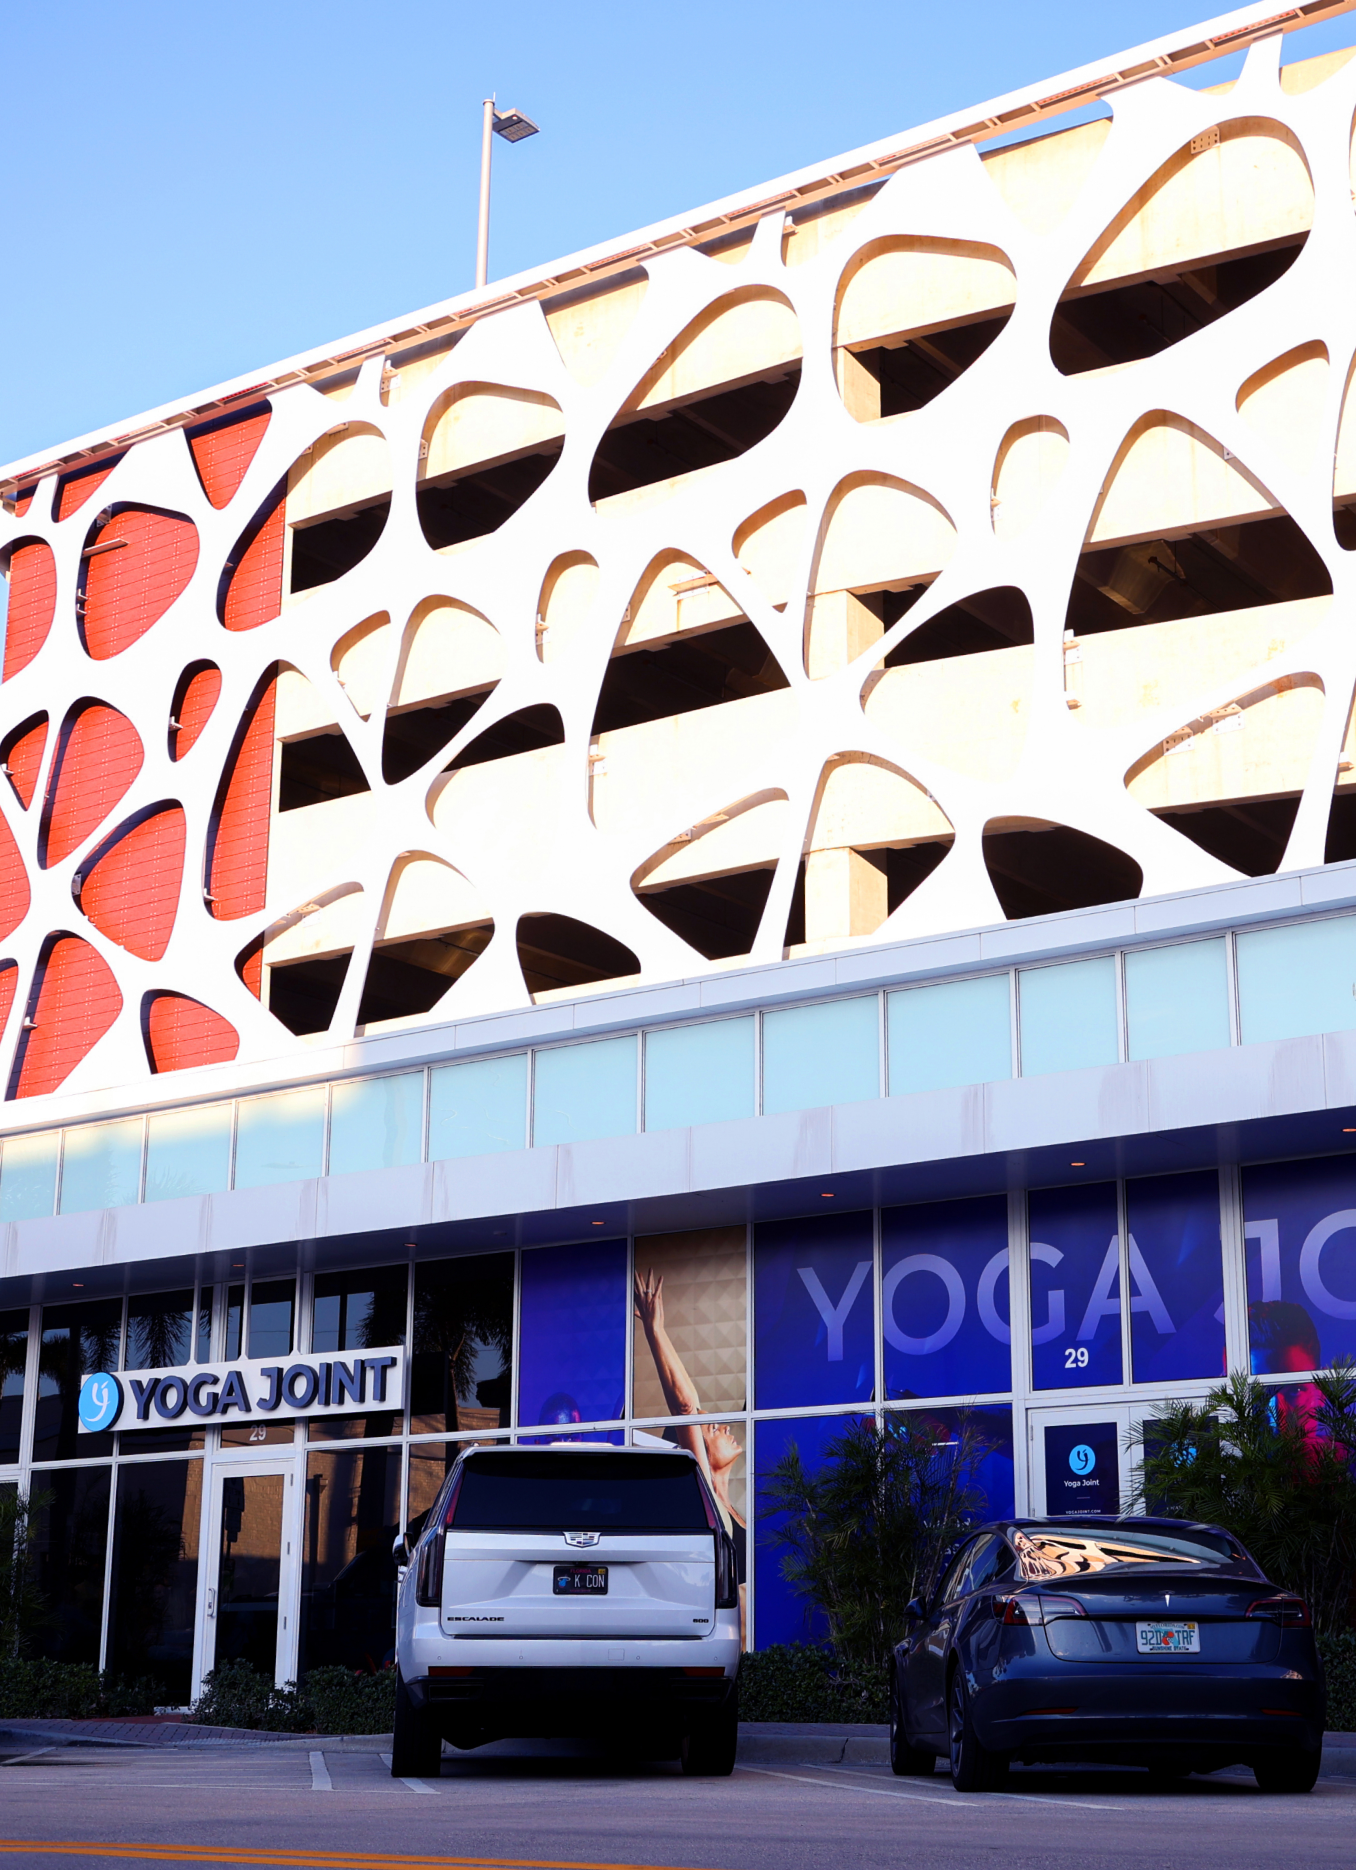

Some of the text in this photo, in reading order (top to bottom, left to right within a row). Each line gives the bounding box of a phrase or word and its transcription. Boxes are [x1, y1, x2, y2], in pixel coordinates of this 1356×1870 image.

[797, 1233, 1177, 1361] YOGA
[1064, 1347, 1089, 1369] 29
[129, 1356, 397, 1420] YOGA JOINT
[249, 1424, 267, 1441] 29
[1063, 1479, 1100, 1489] Yoga Joint
[574, 1574, 605, 1588] K CON
[1174, 1629, 1196, 1646] TRF
